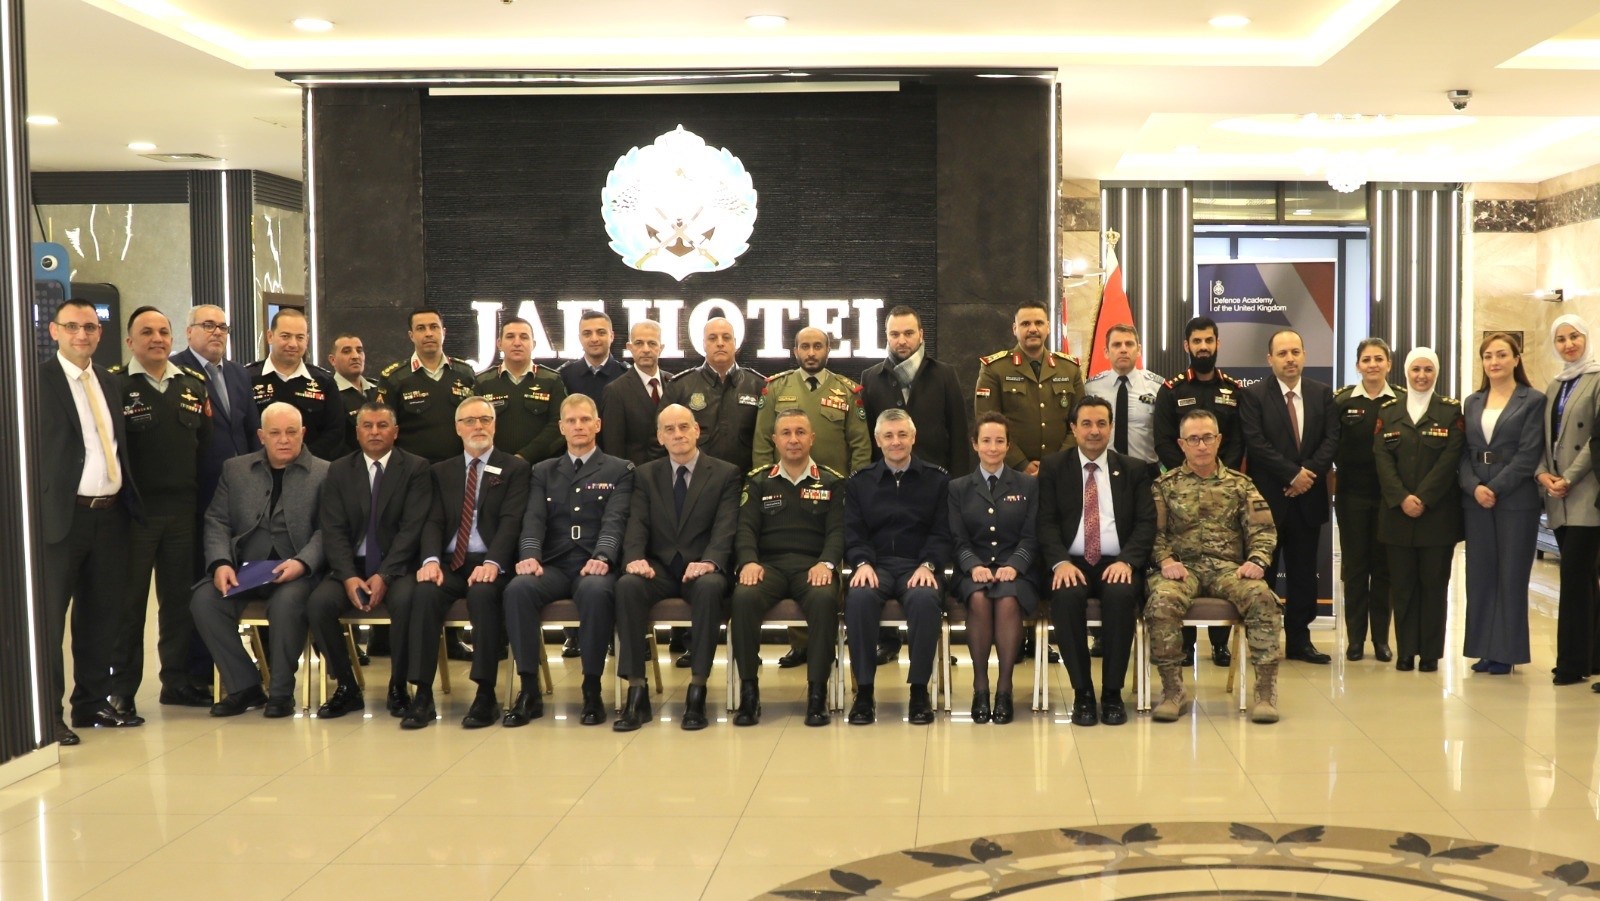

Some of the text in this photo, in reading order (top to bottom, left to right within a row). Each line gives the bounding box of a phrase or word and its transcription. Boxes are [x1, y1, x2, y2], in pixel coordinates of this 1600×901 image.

[1242, 297, 1273, 305] Academy
[1257, 305, 1287, 313] Kingdom
[622, 298, 889, 358] HOTEL
